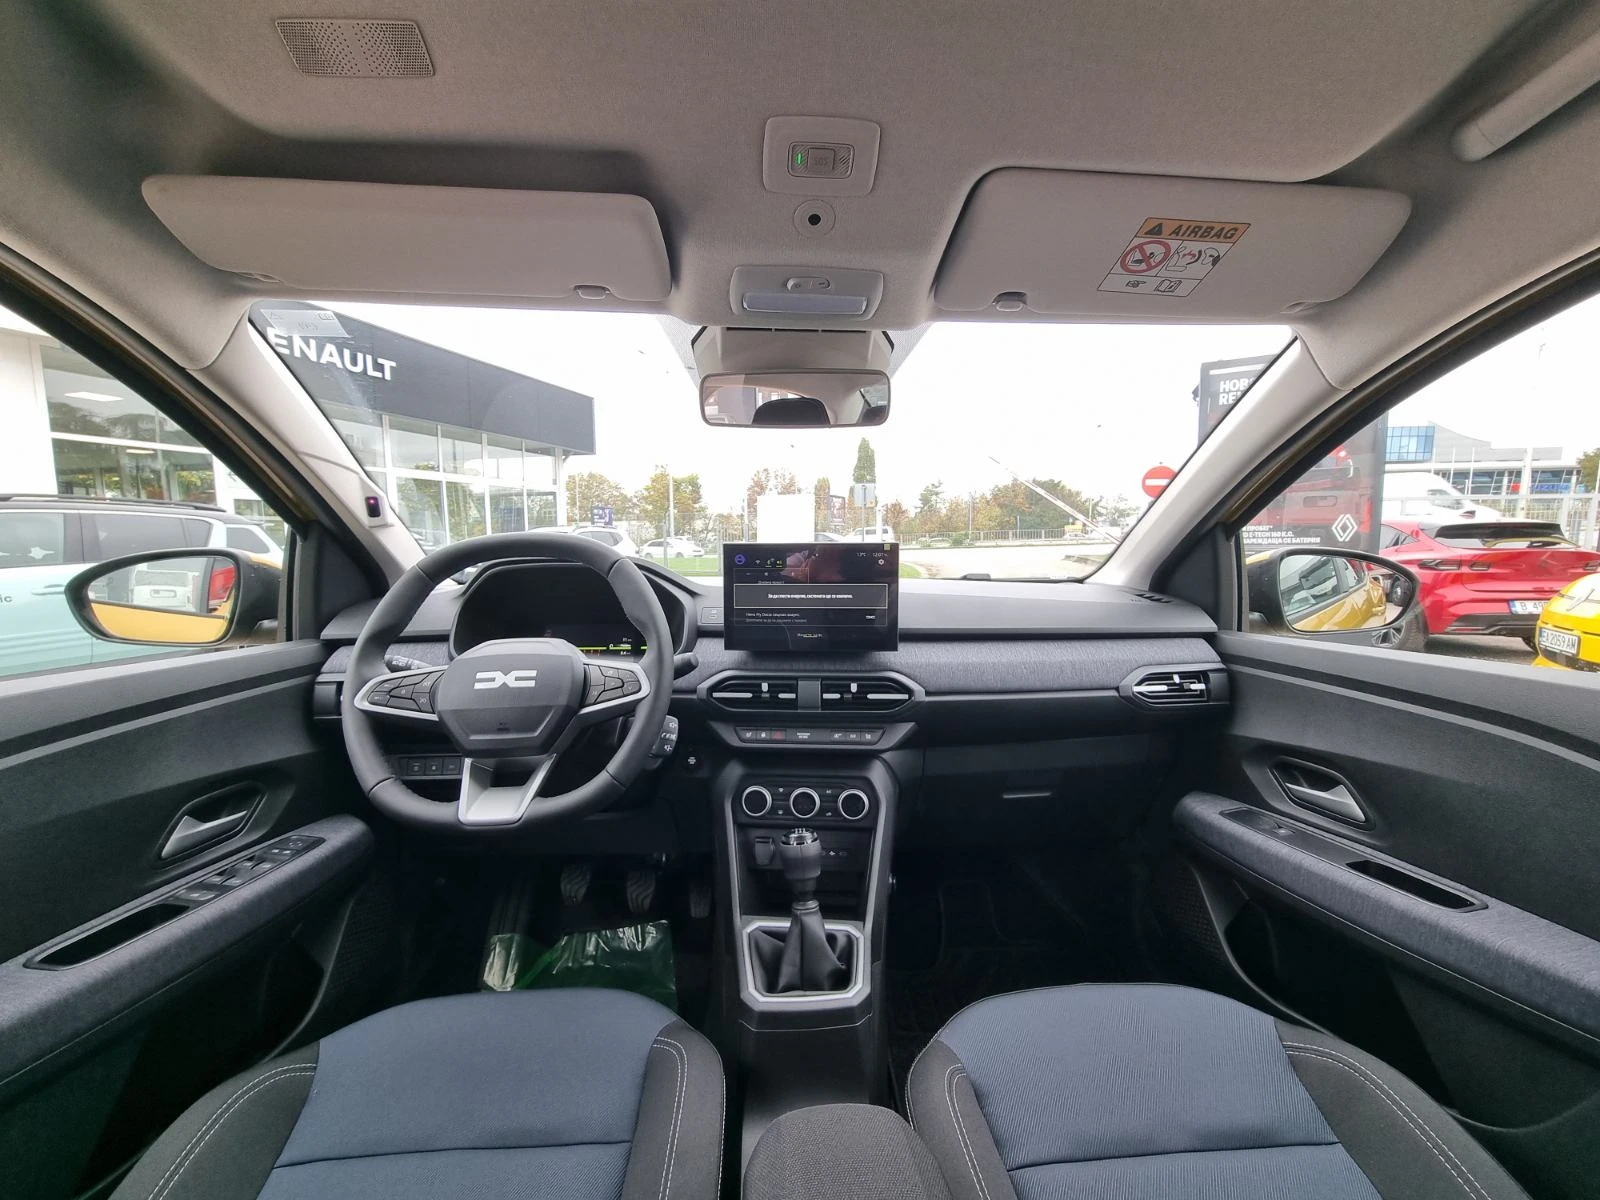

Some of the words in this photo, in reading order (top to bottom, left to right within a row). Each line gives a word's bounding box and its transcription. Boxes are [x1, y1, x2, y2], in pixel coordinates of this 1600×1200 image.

[1168, 224, 1238, 240] AIRBAG
[266, 326, 397, 381] ENAULT
[1219, 377, 1254, 393] НОВ
